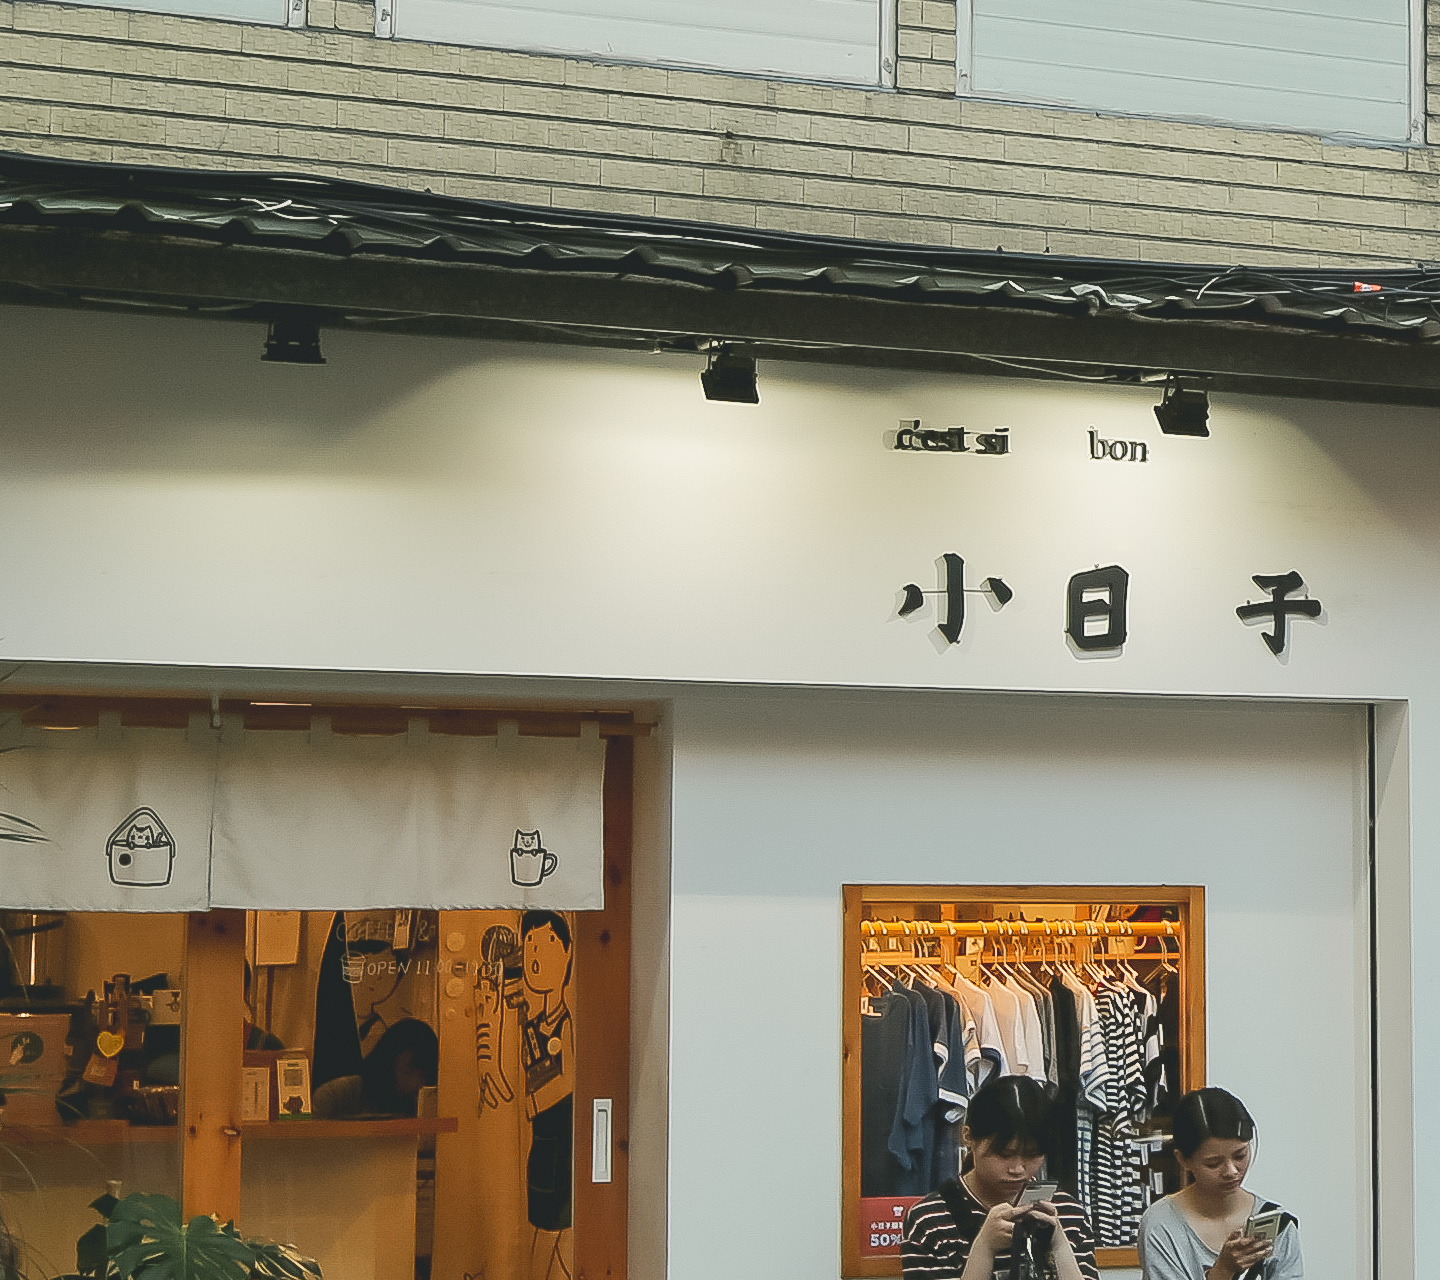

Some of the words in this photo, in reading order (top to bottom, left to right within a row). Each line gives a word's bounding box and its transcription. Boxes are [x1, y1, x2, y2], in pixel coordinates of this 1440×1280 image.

[1087, 427, 1150, 463] bon
[896, 553, 1322, 656] 小日子
[367, 960, 411, 976] OPEN
